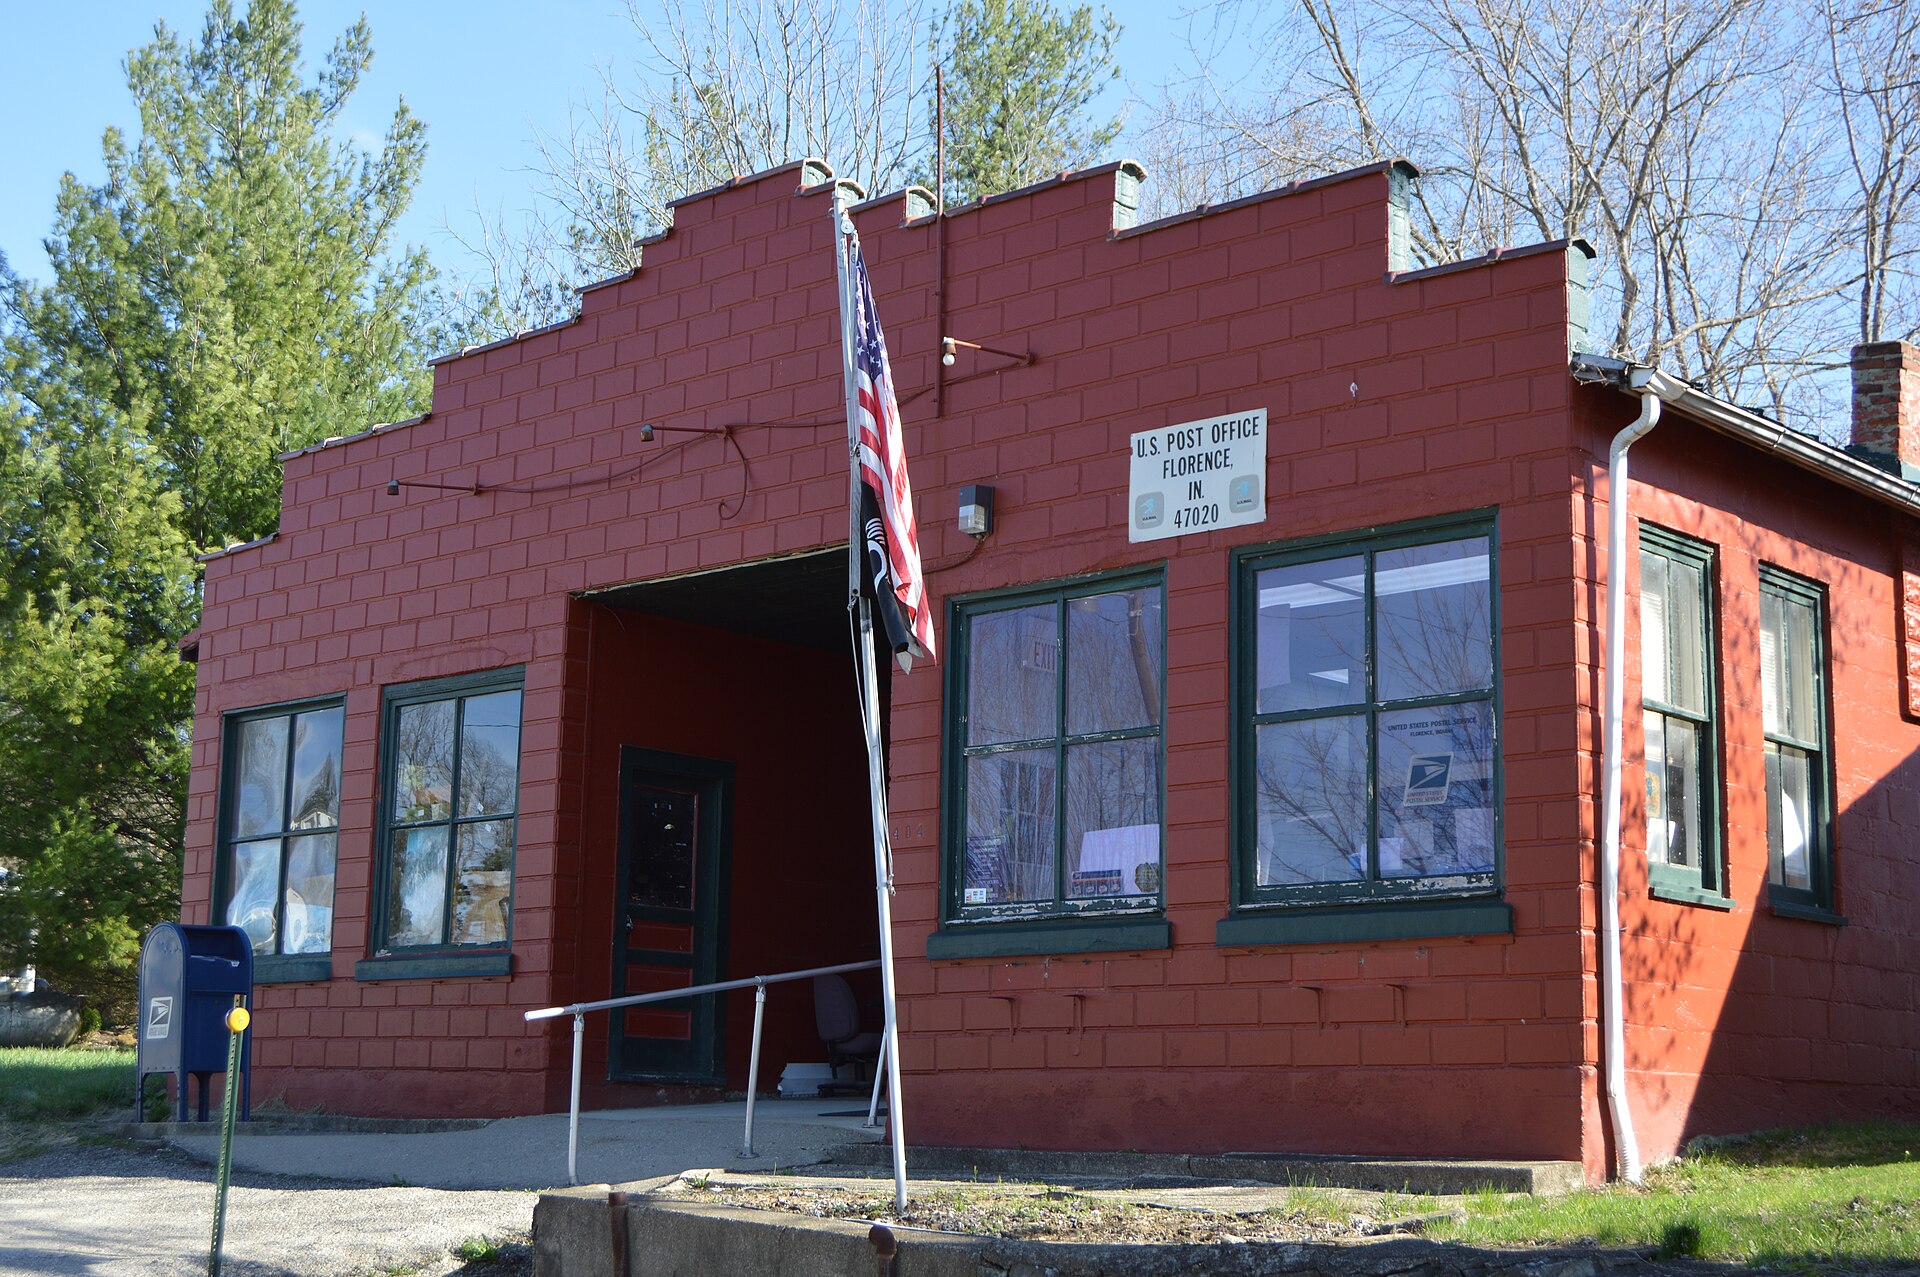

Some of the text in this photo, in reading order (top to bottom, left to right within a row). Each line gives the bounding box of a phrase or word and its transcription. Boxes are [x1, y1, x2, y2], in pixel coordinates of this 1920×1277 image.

[1137, 416, 1259, 458] U.S. POST OFFICE
[1163, 448, 1233, 479] FLORENCE,
[1188, 480, 1204, 500] IN.
[1174, 503, 1219, 528] 47020
[1034, 641, 1056, 671] EXIT
[1430, 719, 1452, 727] POSTAL
[1453, 717, 1477, 725] SERVICE
